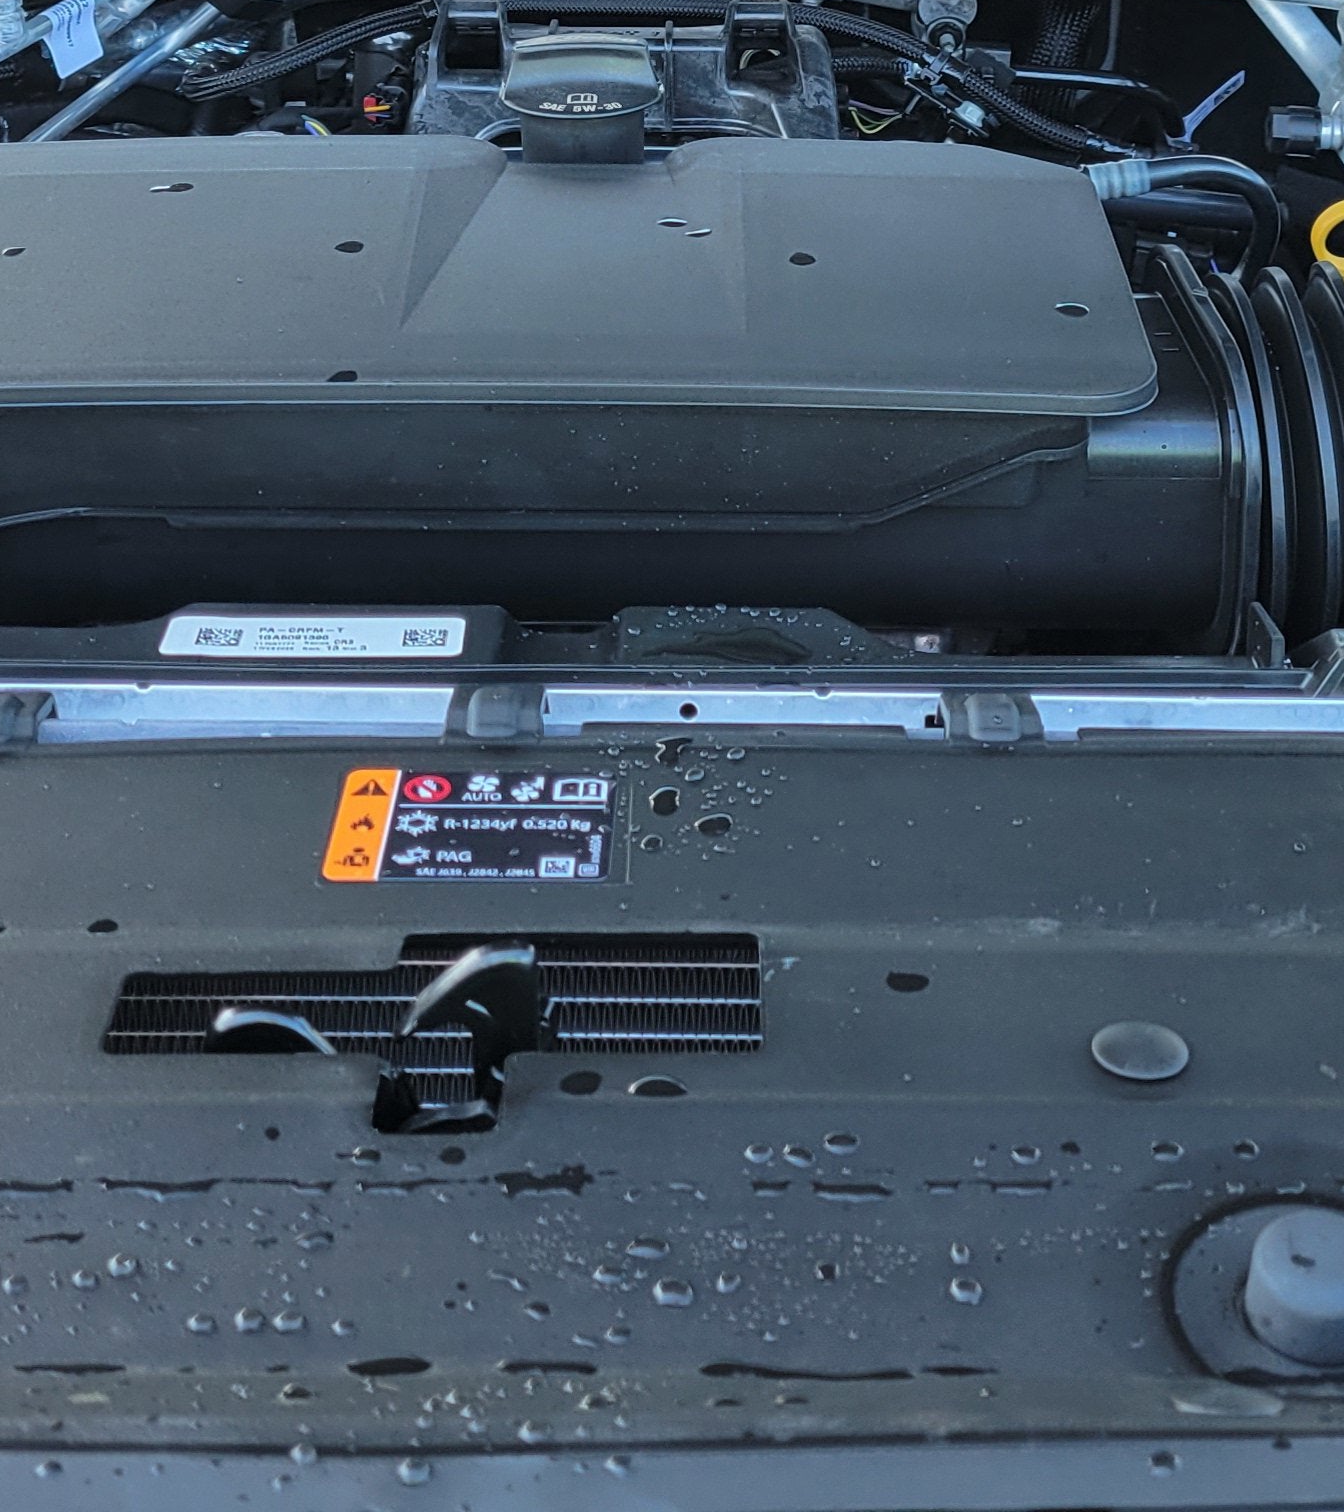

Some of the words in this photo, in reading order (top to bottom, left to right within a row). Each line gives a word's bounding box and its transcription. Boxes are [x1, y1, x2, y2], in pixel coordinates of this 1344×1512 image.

[538, 101, 567, 112] SAE
[572, 101, 623, 113] 5W-30
[461, 792, 503, 802] AUTO
[444, 818, 518, 832] R-1234yf
[522, 819, 568, 830] 0.520
[570, 819, 591, 832] Kg
[436, 850, 473, 863] PAG
